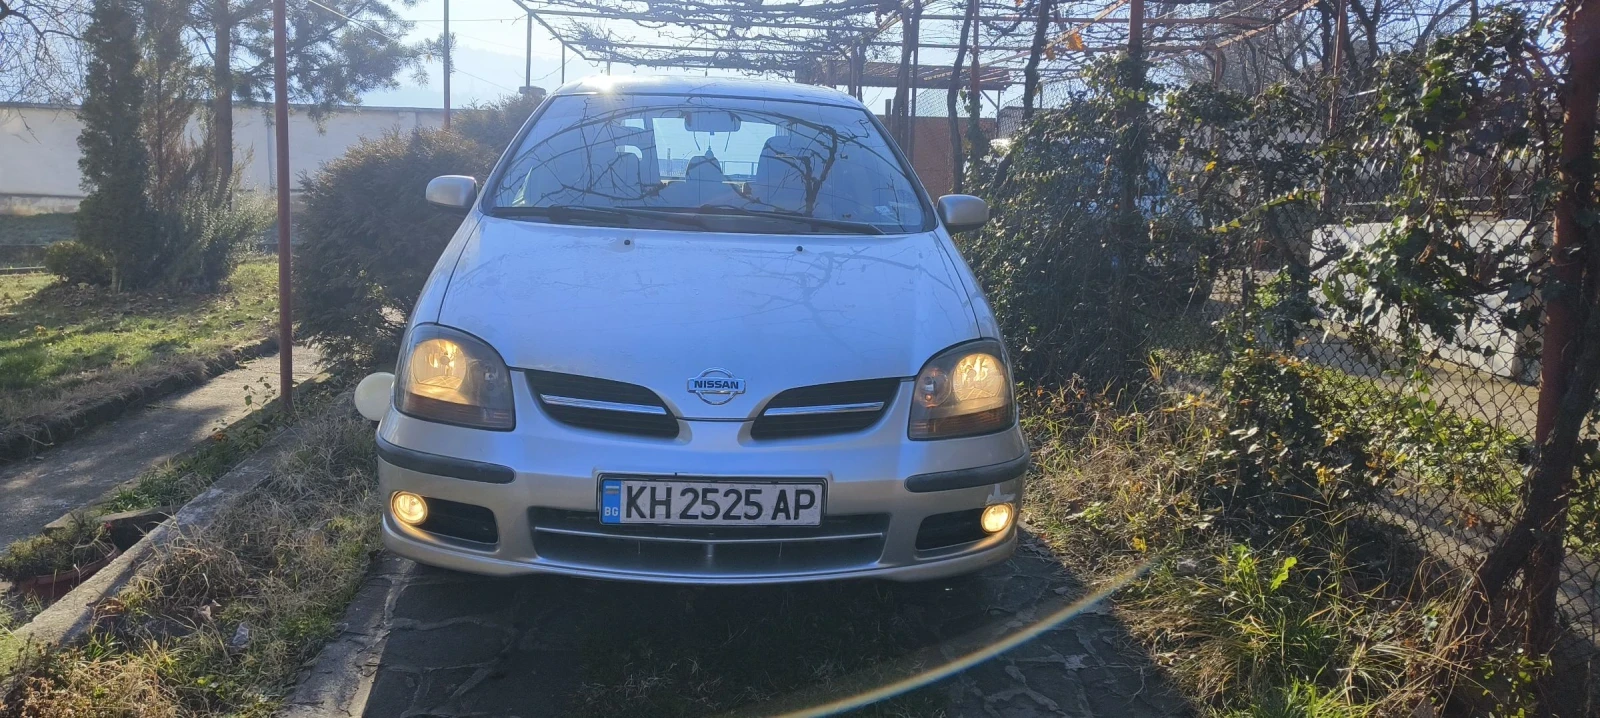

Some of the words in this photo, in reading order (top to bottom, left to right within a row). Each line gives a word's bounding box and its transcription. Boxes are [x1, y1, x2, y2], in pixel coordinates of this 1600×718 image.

[694, 380, 739, 389] NISSAN
[625, 485, 672, 519] KH
[679, 487, 764, 520] 2525
[770, 489, 816, 521] AP
[604, 507, 619, 517] BG
